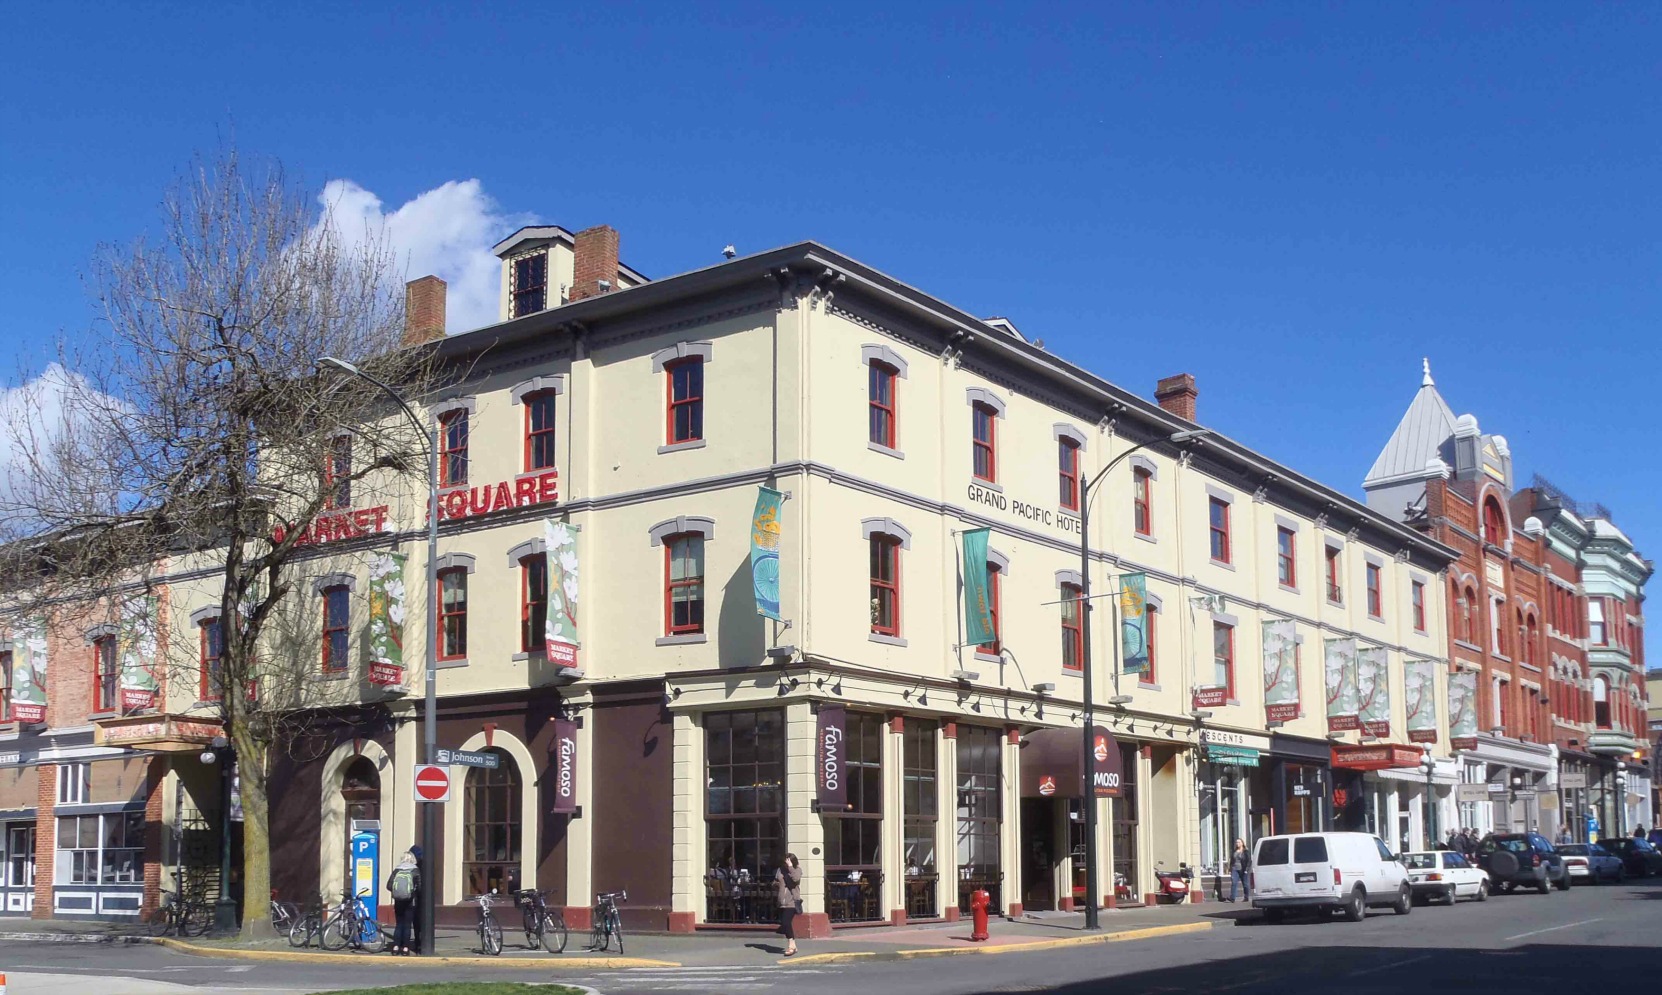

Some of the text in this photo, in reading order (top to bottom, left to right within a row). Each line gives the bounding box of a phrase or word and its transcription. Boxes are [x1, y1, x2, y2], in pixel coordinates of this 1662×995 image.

[967, 484, 1082, 535] GRAND PACIFIC HOTE
[451, 751, 484, 764] Johnson
[359, 841, 370, 853] P
